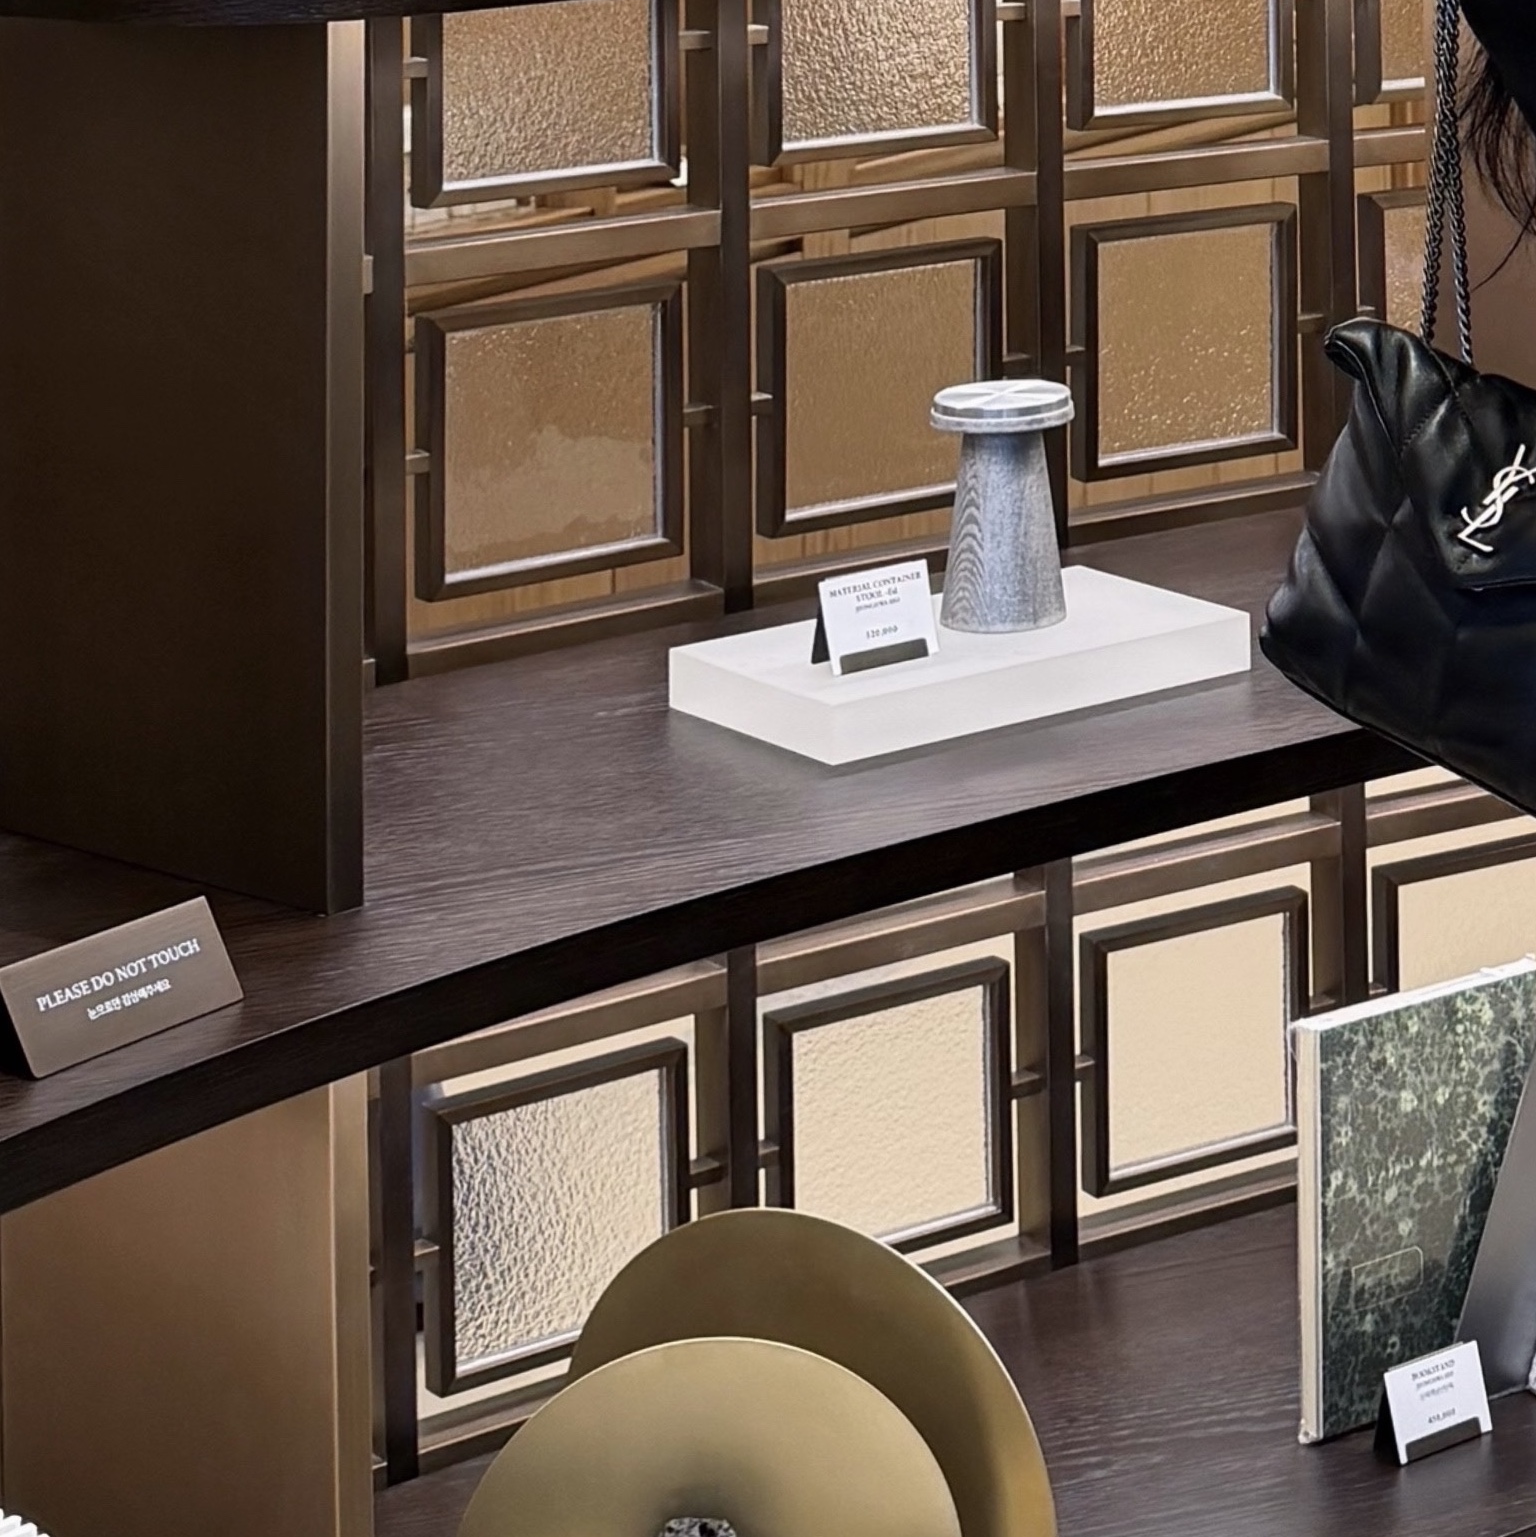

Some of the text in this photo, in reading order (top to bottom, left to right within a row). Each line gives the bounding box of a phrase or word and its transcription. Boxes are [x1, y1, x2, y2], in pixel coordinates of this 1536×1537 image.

[36, 938, 201, 1012] PLEASE DO NOT TOUCH
